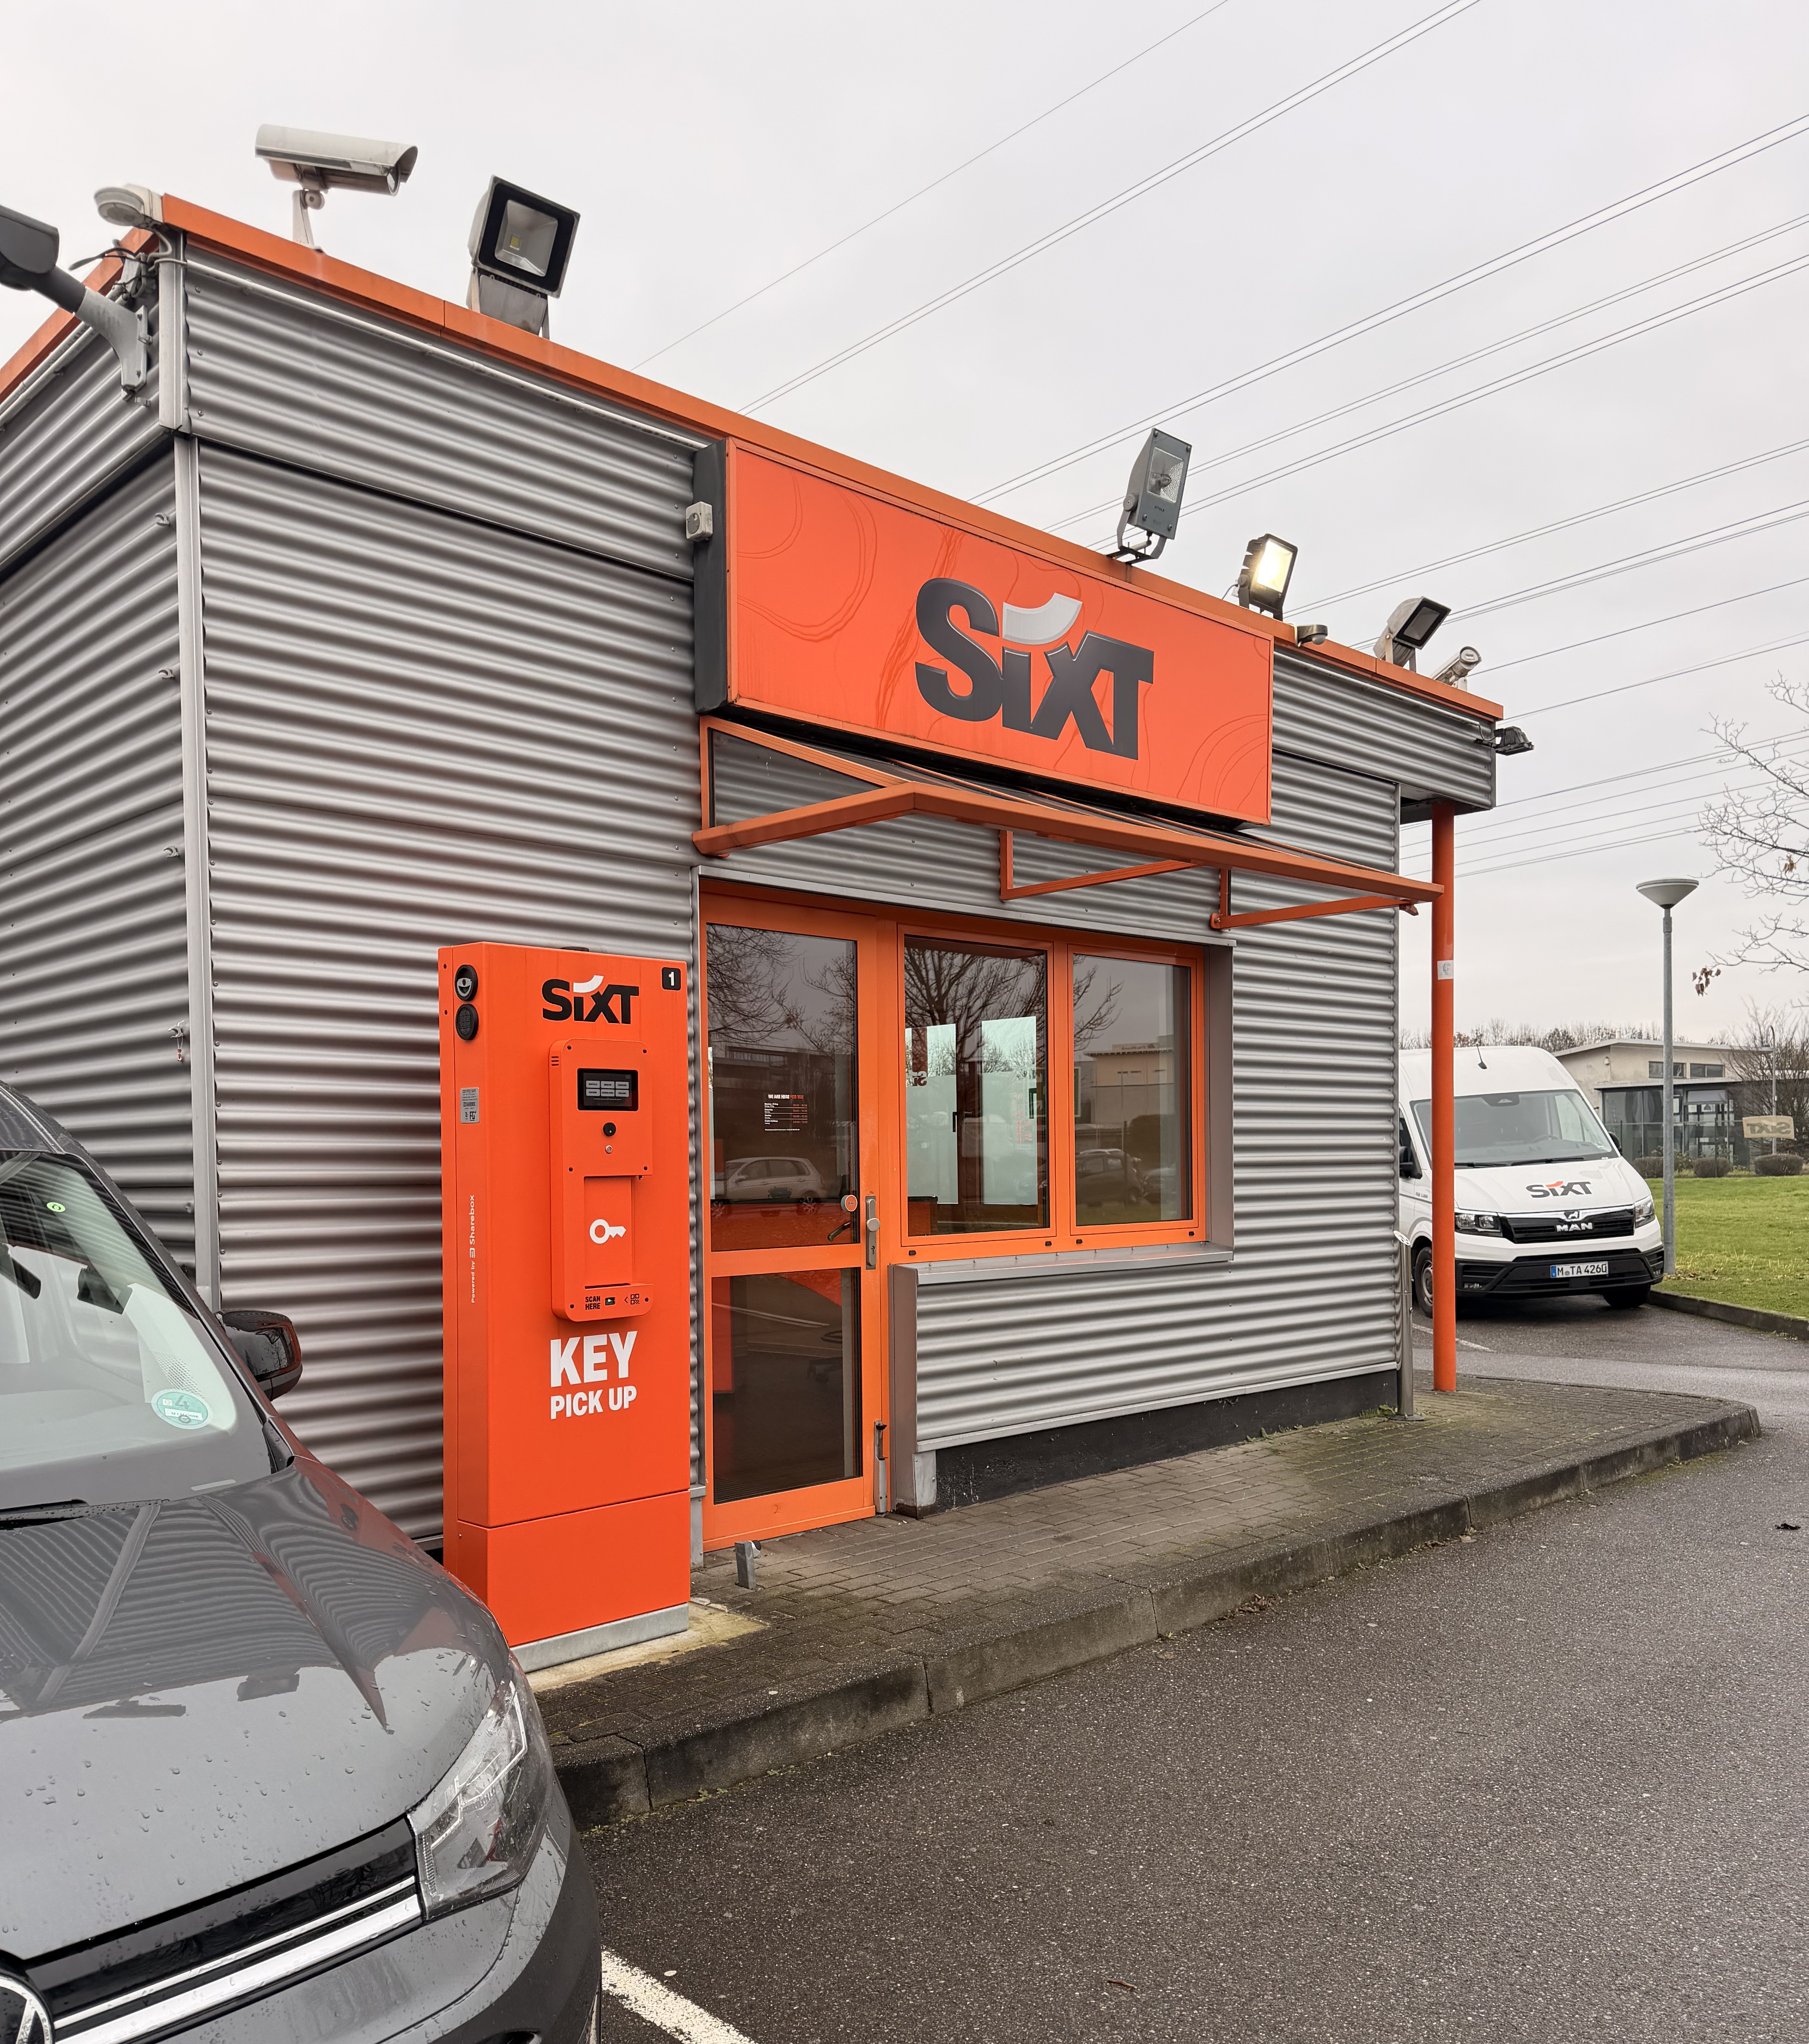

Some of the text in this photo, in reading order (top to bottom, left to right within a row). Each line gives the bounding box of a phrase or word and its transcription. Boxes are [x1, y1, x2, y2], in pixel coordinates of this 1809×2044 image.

[915, 577, 1154, 760] SIXT
[668, 971, 675, 986] 1
[542, 974, 639, 1025] SIXT
[1526, 1181, 1592, 1198] SIXT
[1556, 1222, 1593, 1232] MAN
[471, 1260, 475, 1269] by
[1557, 1263, 1607, 1276] M TA 4260
[550, 1330, 638, 1388] KEY
[175, 1395, 190, 1409] 4
[550, 1385, 638, 1420] PICK UP
